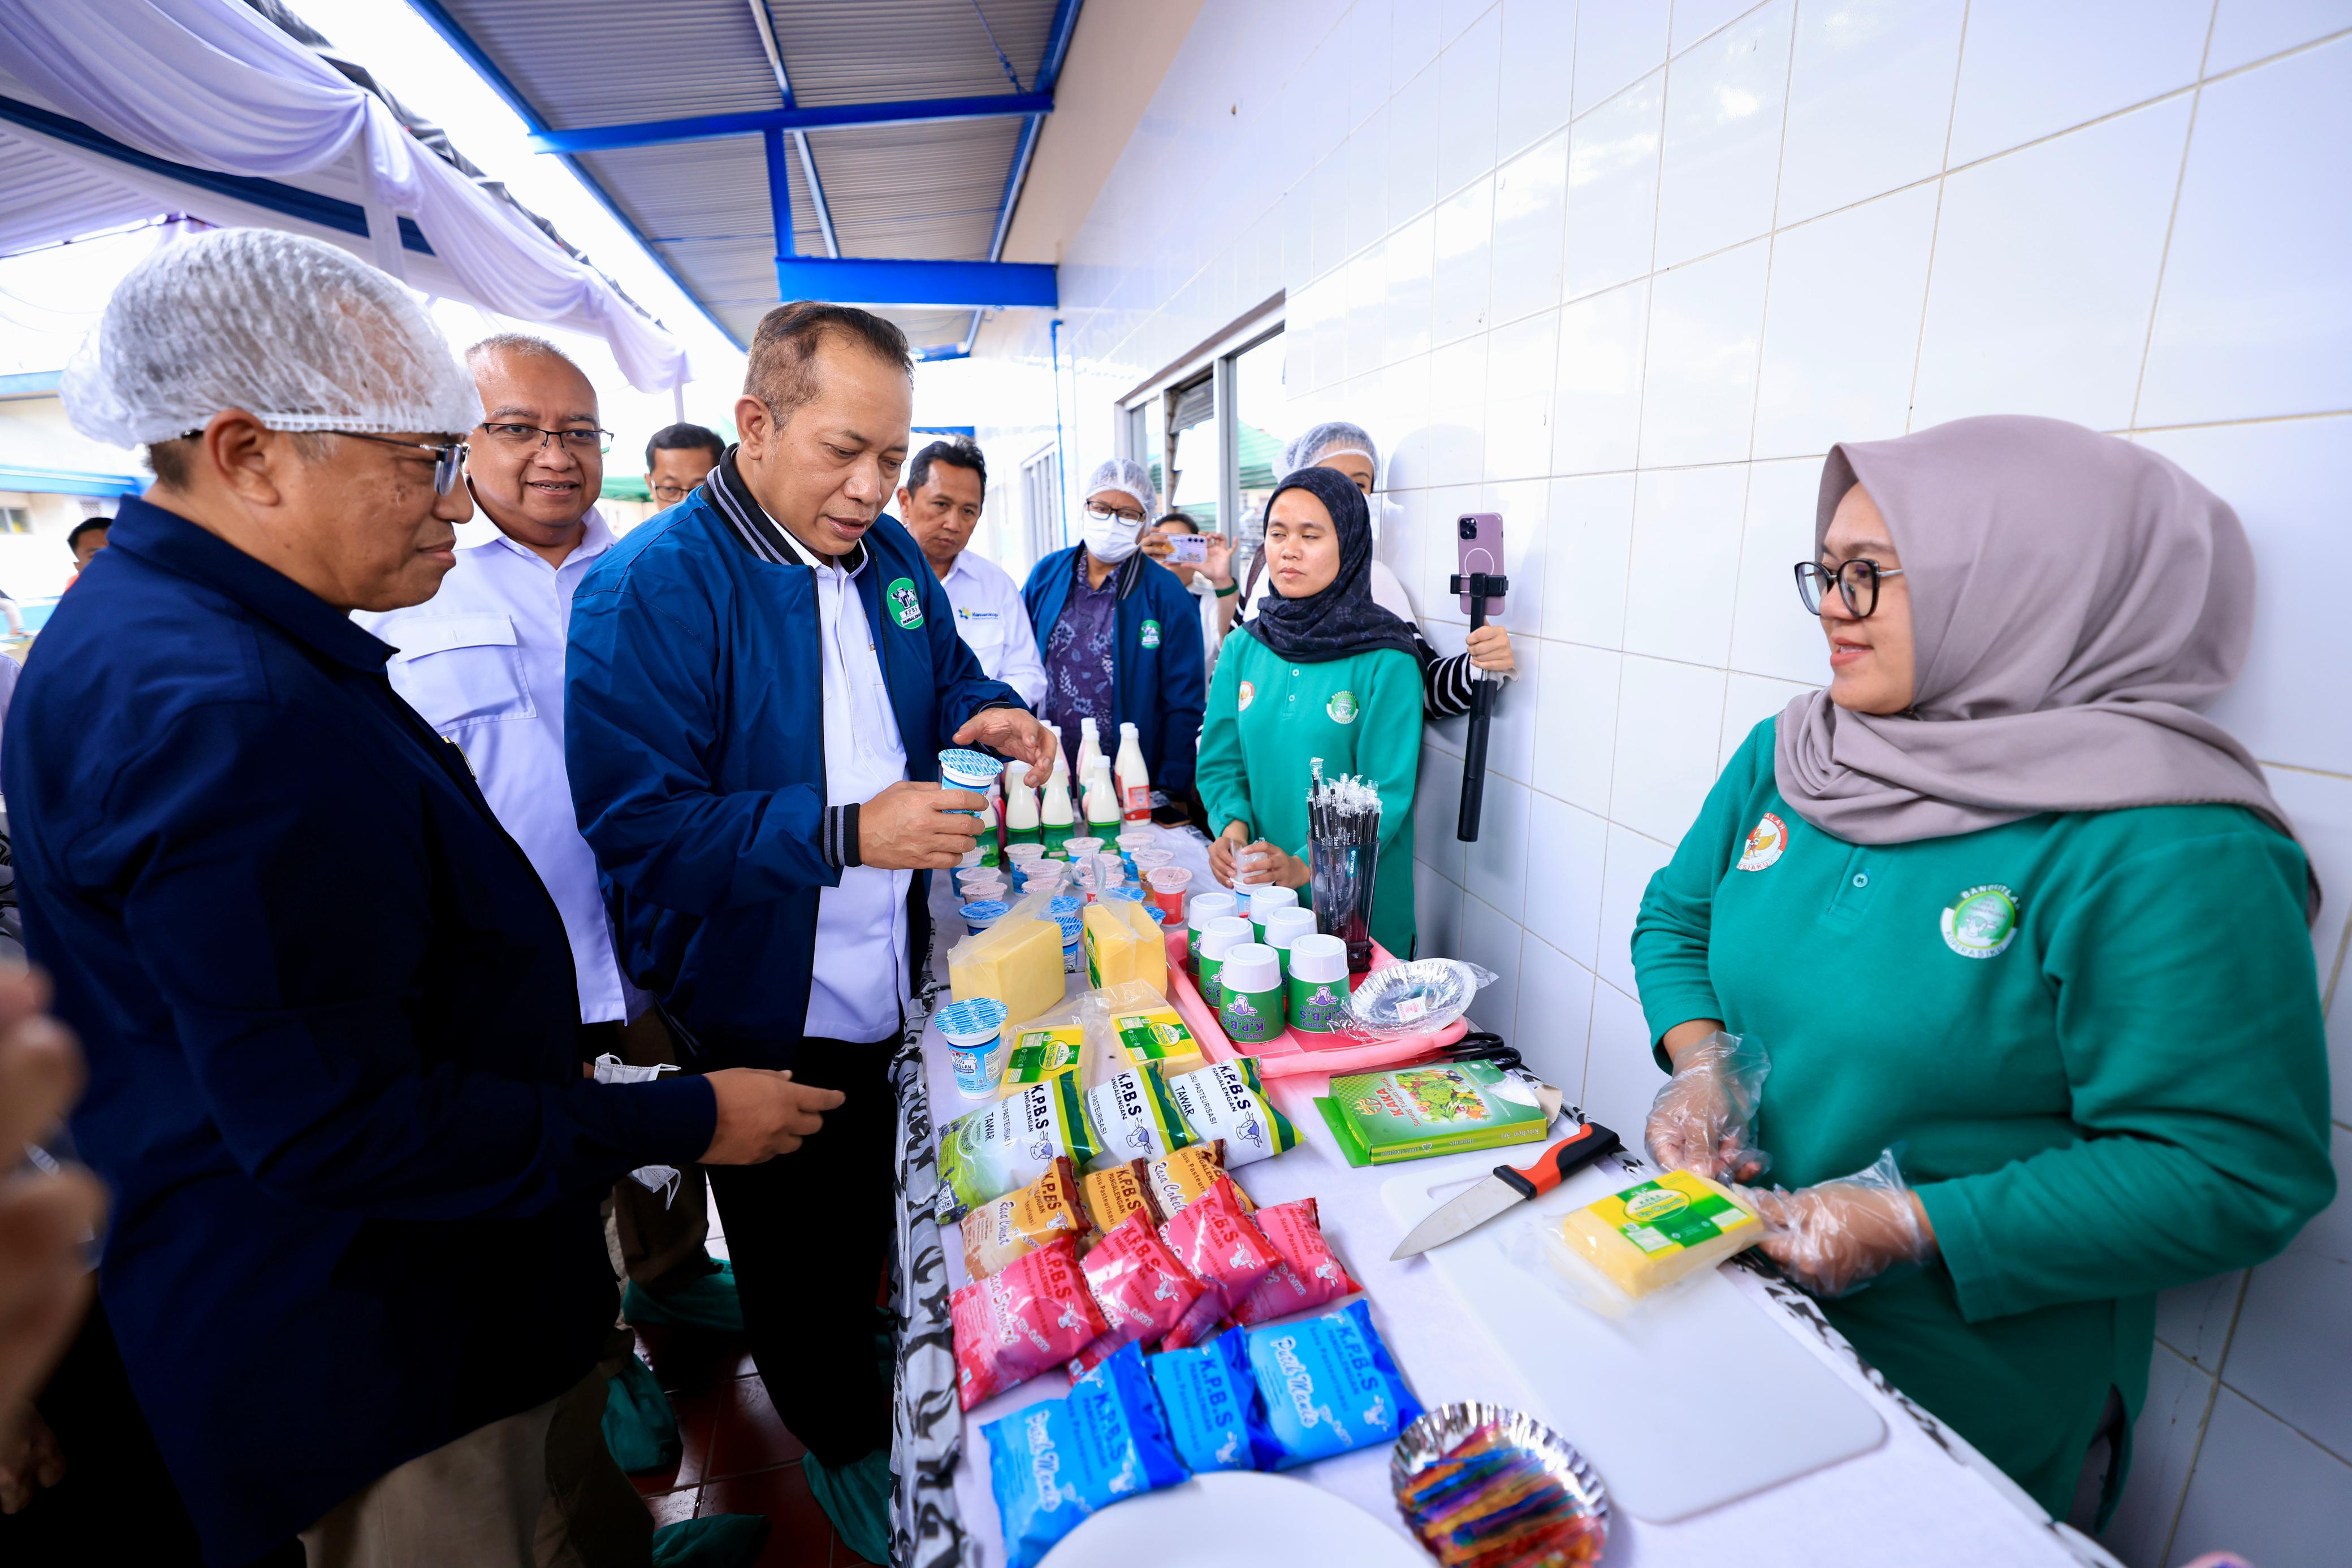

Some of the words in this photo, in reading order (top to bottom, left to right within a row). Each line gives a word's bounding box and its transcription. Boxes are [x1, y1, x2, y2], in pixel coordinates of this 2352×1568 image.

[905, 606, 918, 616] KPBS
[1765, 813, 1785, 830] ALAH
[1221, 1016, 1265, 1032] K.P.B.S
[1222, 1010, 1265, 1022] PANGALENGAN
[1030, 1084, 1049, 1130] K.P.B.S
[1111, 1076, 1127, 1121] ANGALENGAN
[1117, 1071, 1143, 1116] K.P.B.S
[1175, 1085, 1195, 1117] TAWAR
[1194, 1081, 1217, 1125] PASTEURISASI
[1211, 1068, 1238, 1112] PANGALENGAN
[1218, 1064, 1251, 1111] K.P.B.S
[1376, 1088, 1404, 1117] KAKA
[984, 1112, 995, 1142] TAWAR
[1002, 1107, 1012, 1147] PASTEURISASI
[1023, 1089, 1034, 1133] ANGALENGAN
[1091, 1094, 1108, 1136] PASTEURISASI
[1405, 1108, 1421, 1127] Sarung
[1514, 1128, 1540, 1138] Kitchen
[1095, 1172, 1104, 1185] Susu
[1116, 1169, 1141, 1210] K.P.B.S
[1154, 1162, 1169, 1184] Rasa
[998, 1201, 1015, 1220] Rasa
[1099, 1185, 1118, 1225] Pasteurisasi
[1108, 1173, 1127, 1215] PANGALENGAN
[1121, 1227, 1161, 1274] K.P.B.S
[1287, 1208, 1314, 1255] PANGALENGAN
[1043, 1247, 1072, 1300] K.P.B.S
[1288, 1274, 1307, 1297] 4.000
[1130, 1308, 1155, 1328] 4.000
[1271, 1337, 1305, 1376] Putih
[1337, 1327, 1378, 1392] K.P.B.S
[1198, 1359, 1234, 1428] K.P.B.S
[1287, 1373, 1318, 1427] Manis
[1093, 1391, 1126, 1462] K.P.B.S
